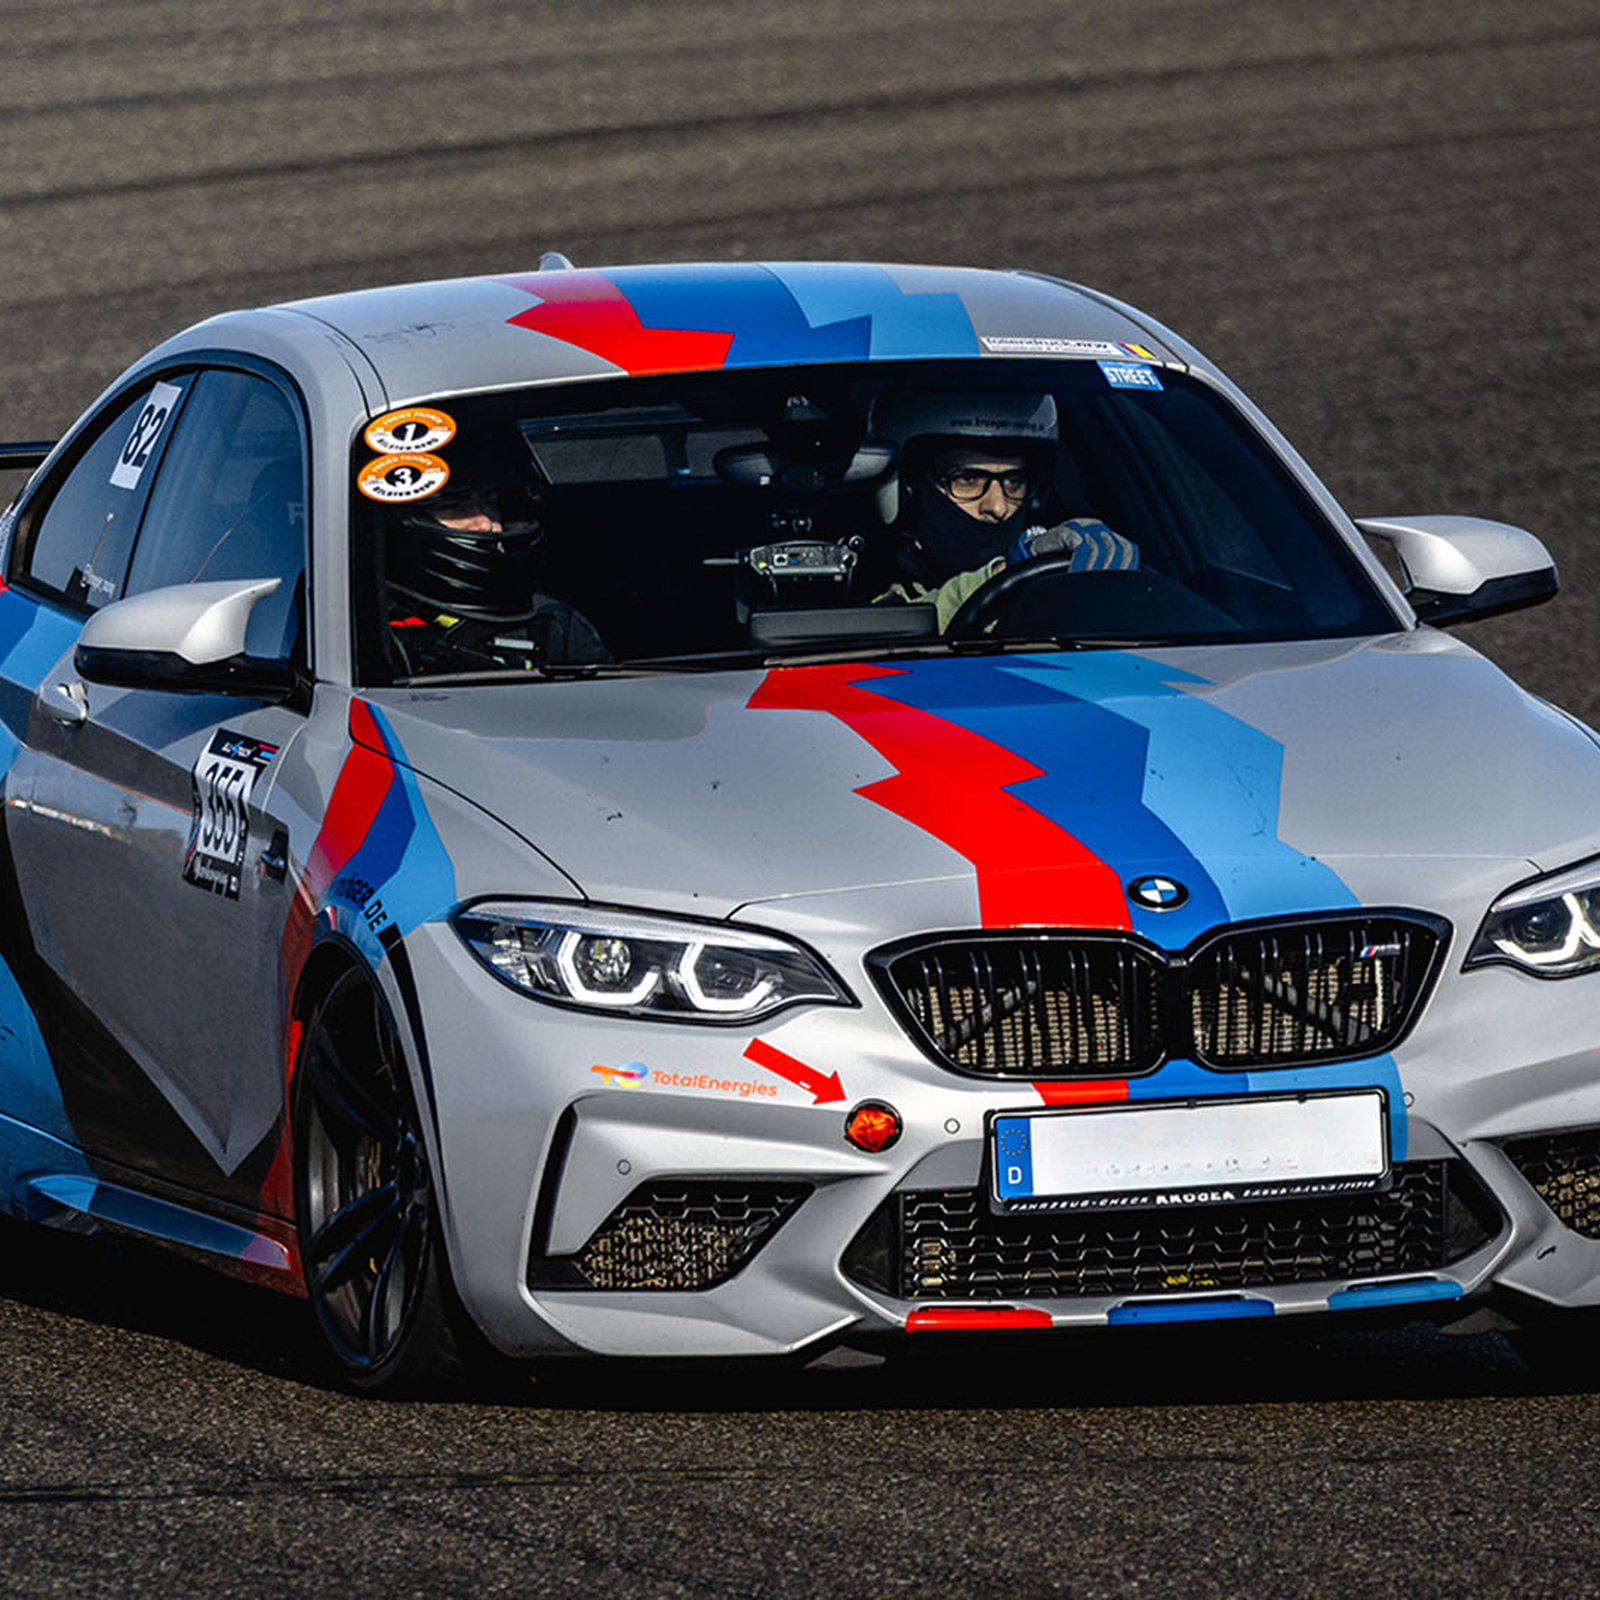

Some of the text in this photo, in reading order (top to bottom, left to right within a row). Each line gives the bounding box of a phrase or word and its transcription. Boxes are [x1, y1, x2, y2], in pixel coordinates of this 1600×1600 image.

[1103, 366, 1157, 386] STREET
[121, 403, 168, 468] 82
[404, 422, 417, 442] 1
[394, 466, 413, 488] 3
[202, 761, 245, 854] 355
[652, 1069, 778, 1098] TotalEnergies
[1007, 1166, 1023, 1185] D
